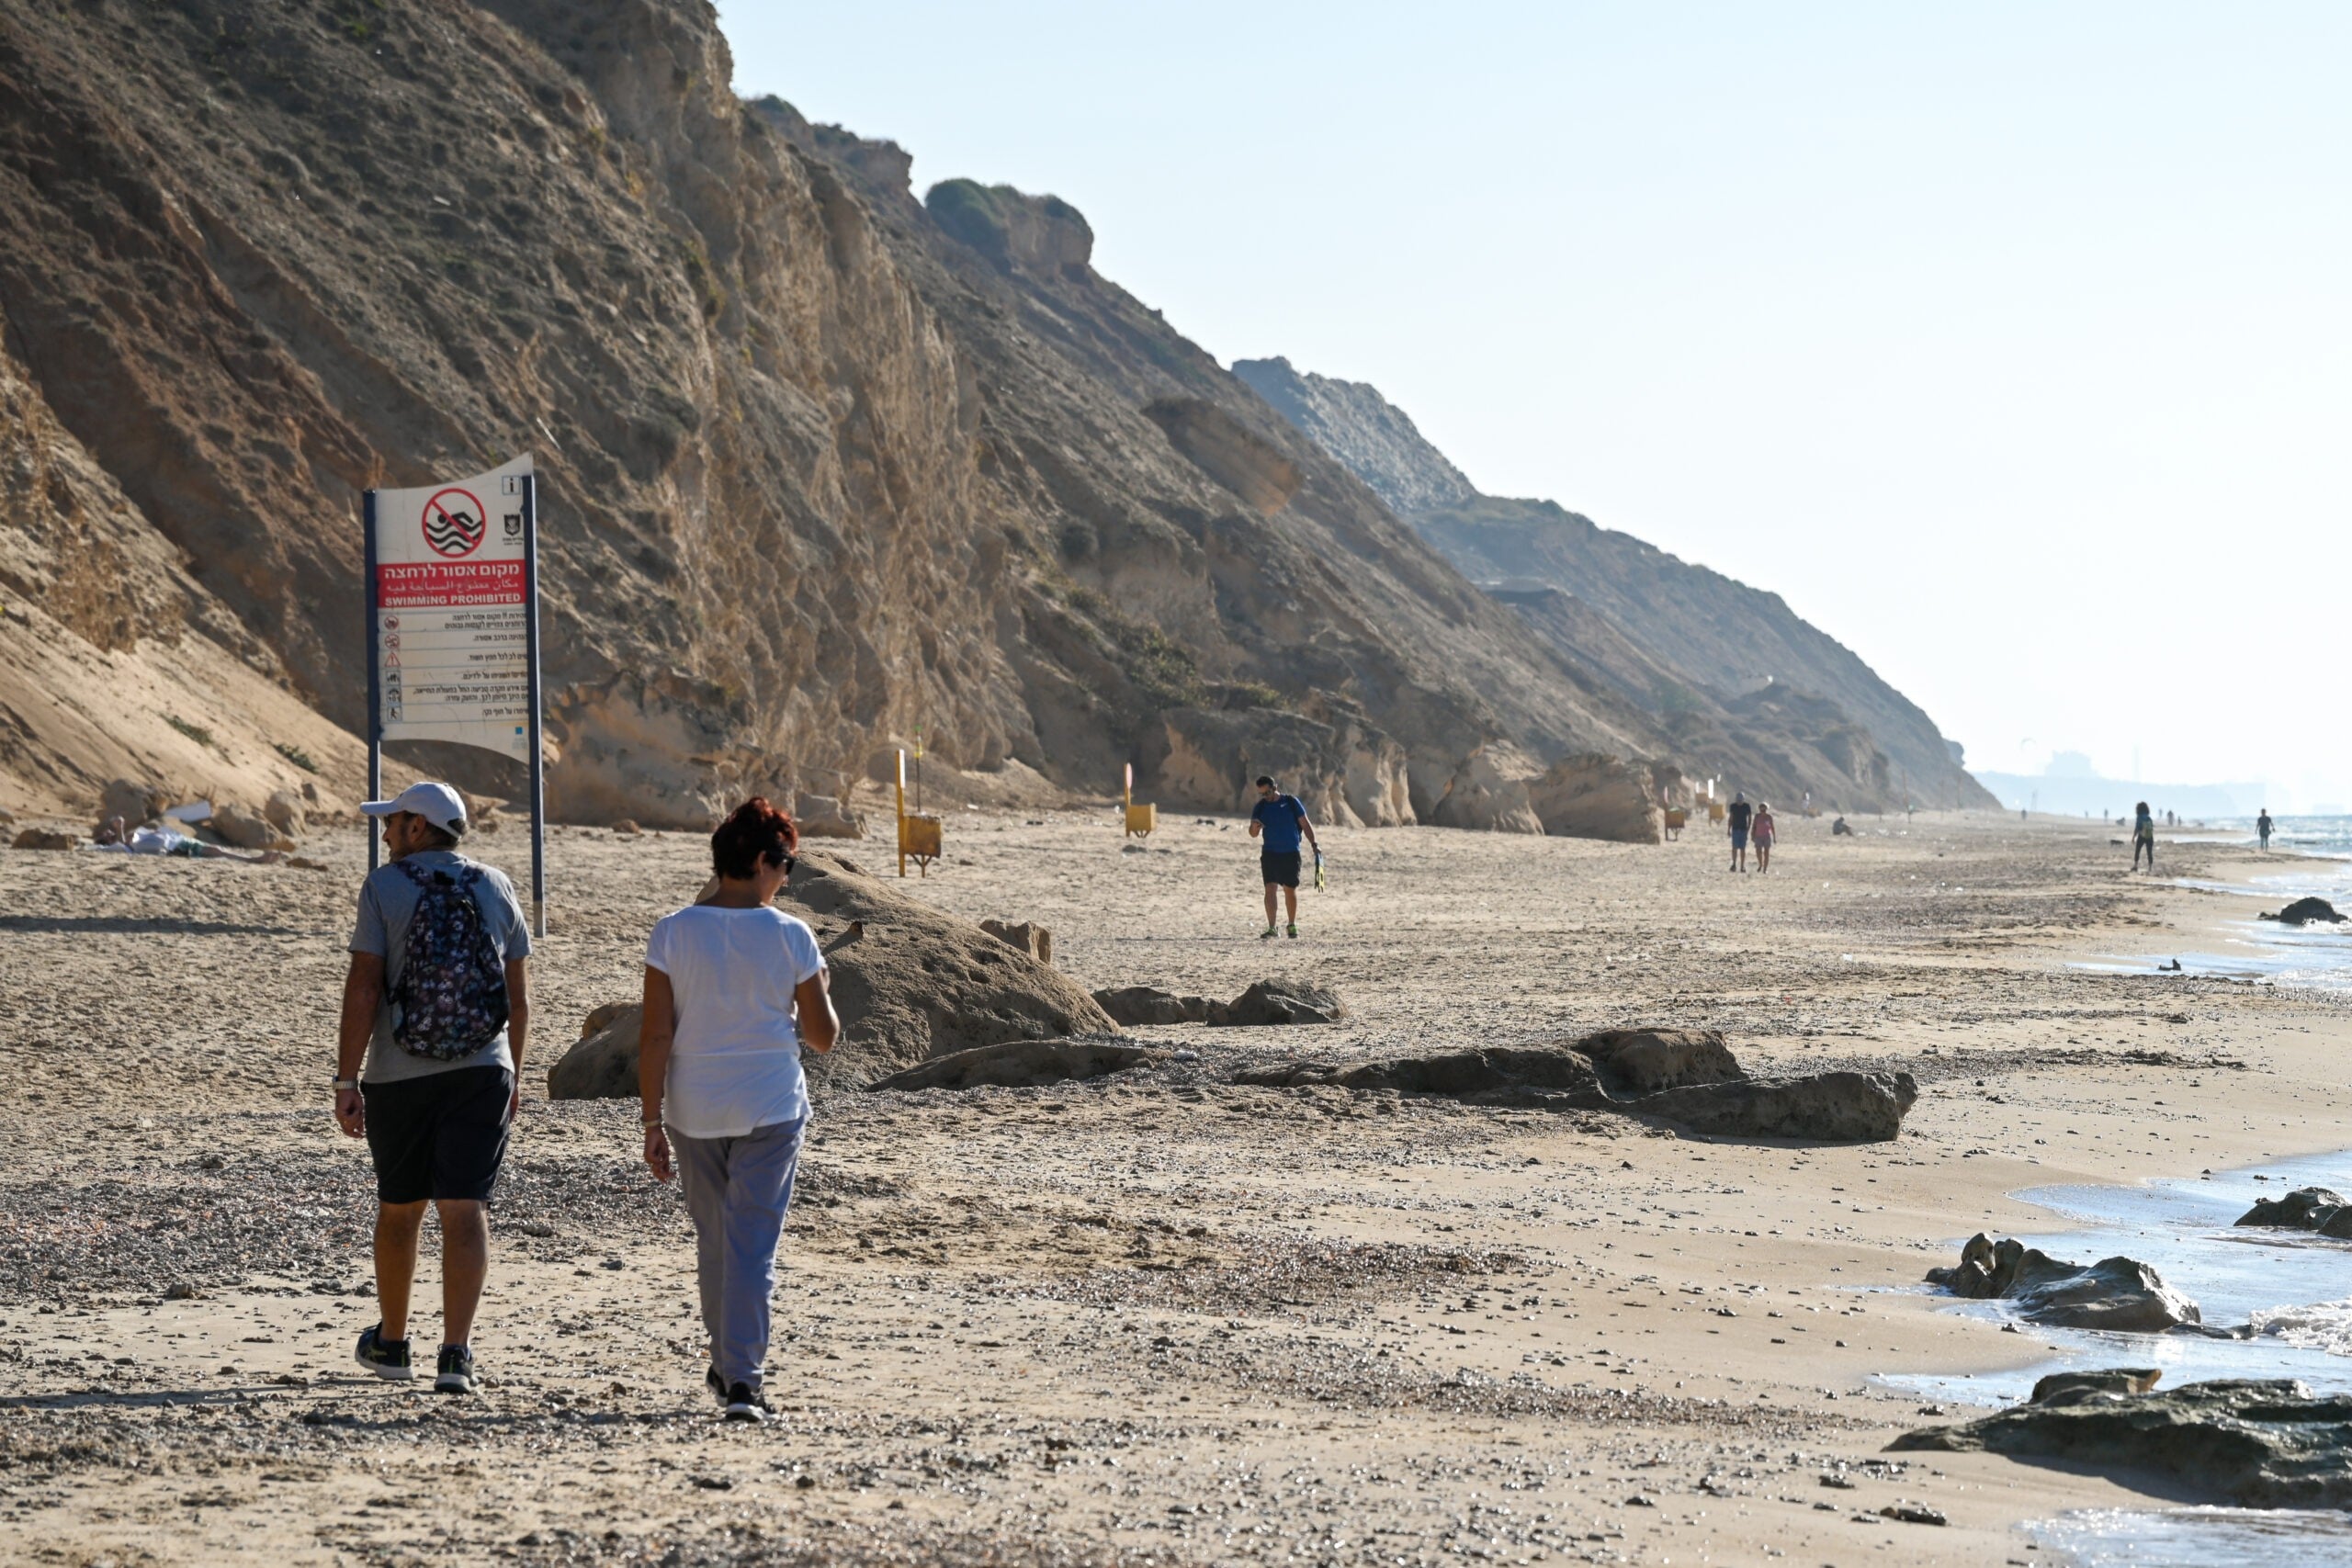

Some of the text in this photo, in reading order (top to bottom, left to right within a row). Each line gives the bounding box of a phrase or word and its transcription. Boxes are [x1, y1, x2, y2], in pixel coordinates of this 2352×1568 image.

[384, 563, 520, 579] מקום אסור לרחצה
[386, 578, 519, 594] مكان ممنوع السباحة فيه
[450, 592, 521, 604] PROHIBITED
